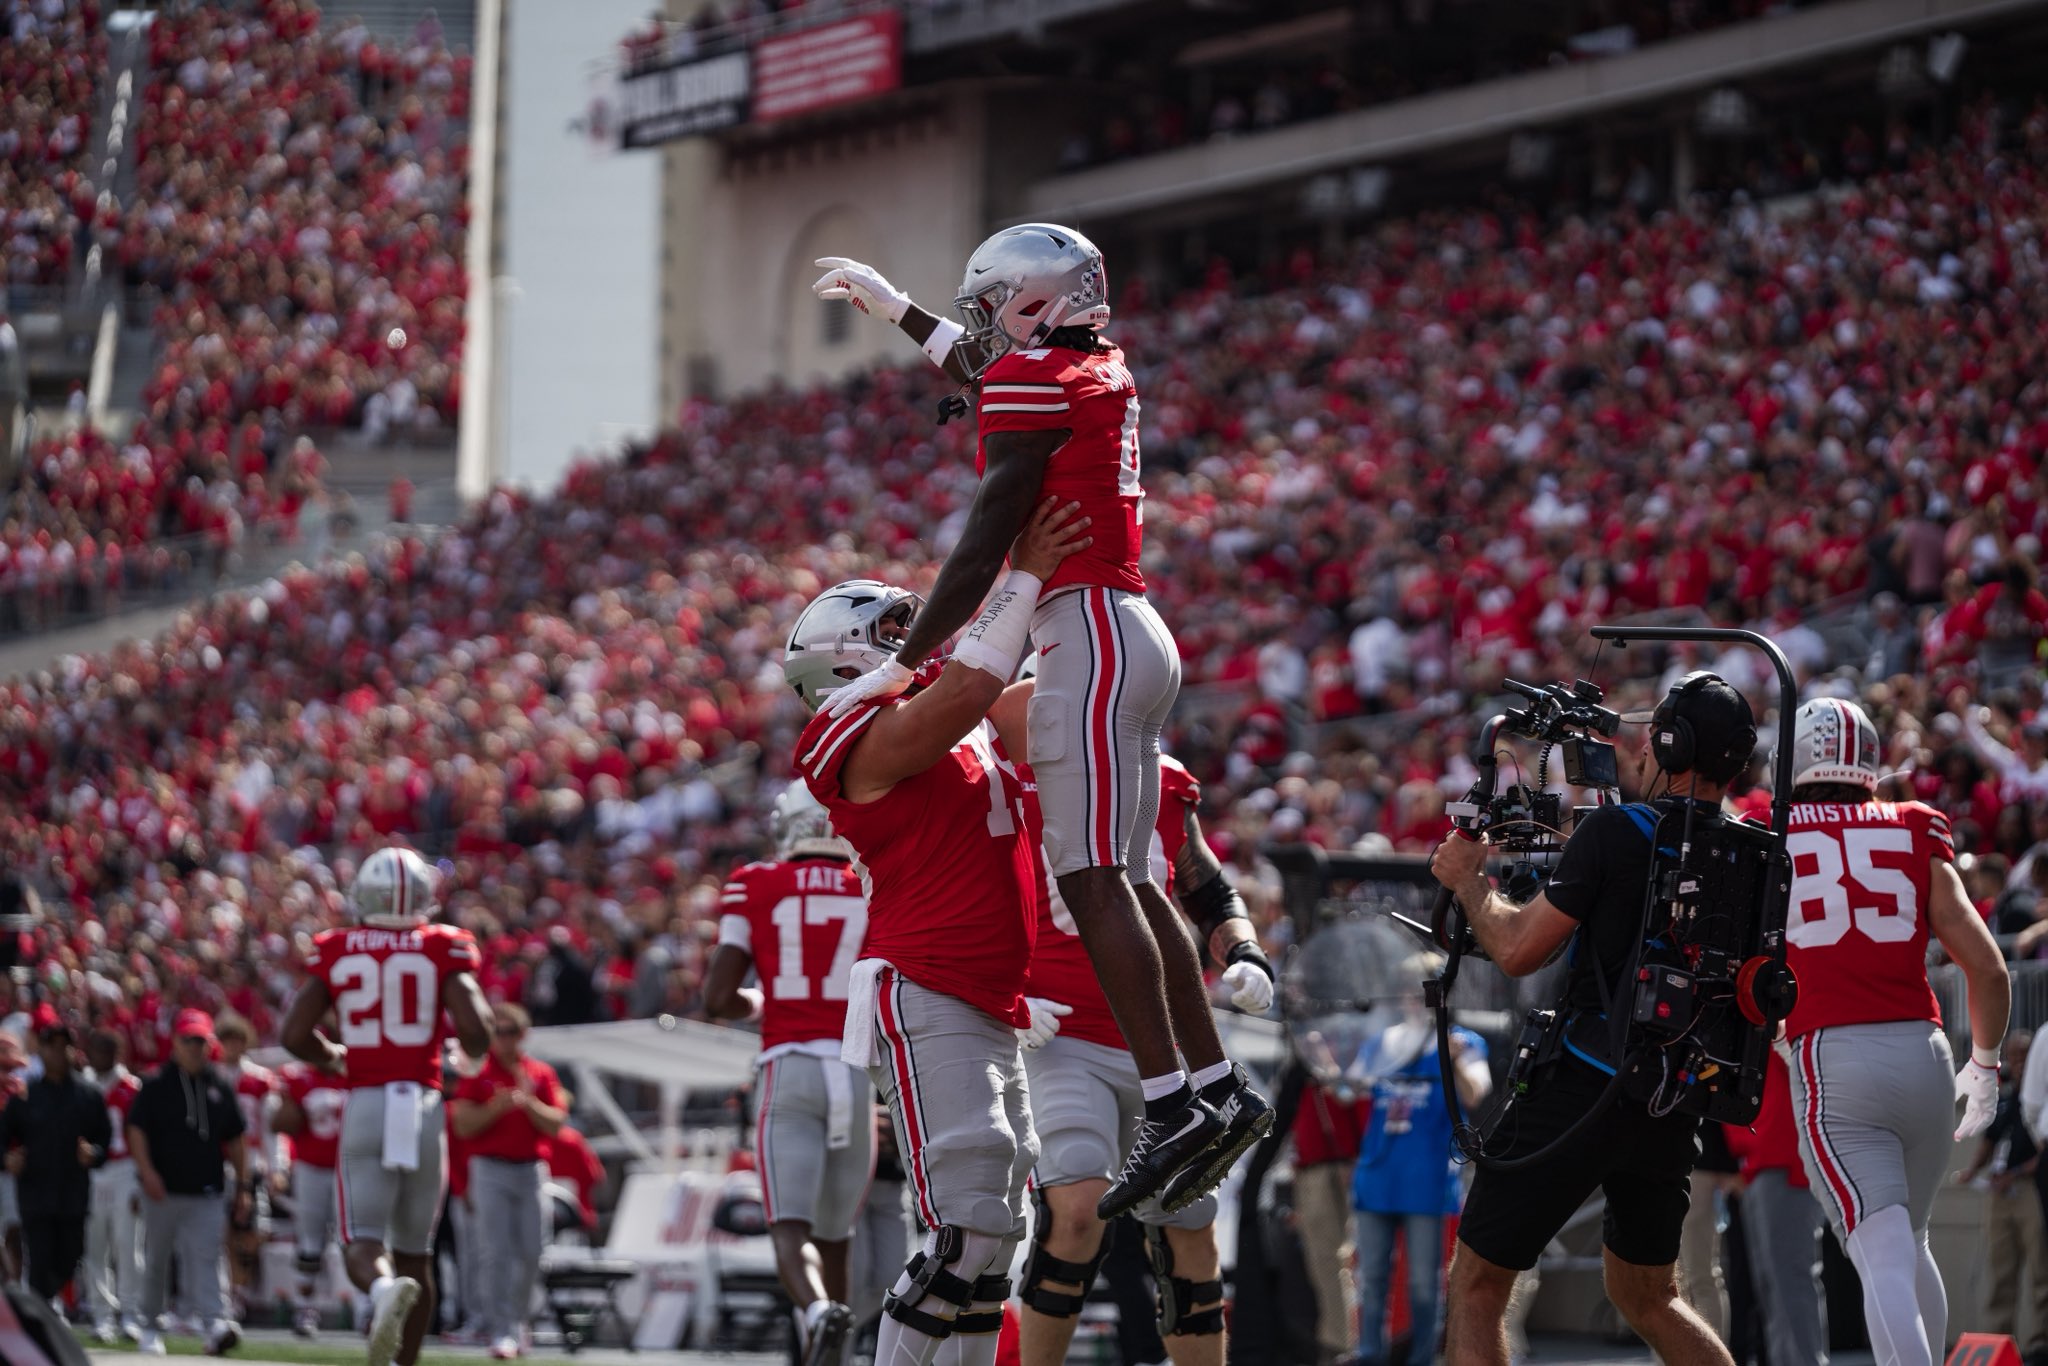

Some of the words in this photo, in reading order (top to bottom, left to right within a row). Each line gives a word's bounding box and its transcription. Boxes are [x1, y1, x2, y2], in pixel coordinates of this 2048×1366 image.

[968, 602, 1007, 642] ISAIAH
[1813, 770, 1875, 783] BUCKEYES
[1788, 801, 1898, 825] HRISTIAN
[795, 866, 847, 892] TATE
[1785, 827, 1917, 949] 85
[346, 929, 424, 953] PEOPLES
[771, 894, 869, 1000] 17
[329, 953, 438, 1048] 20
